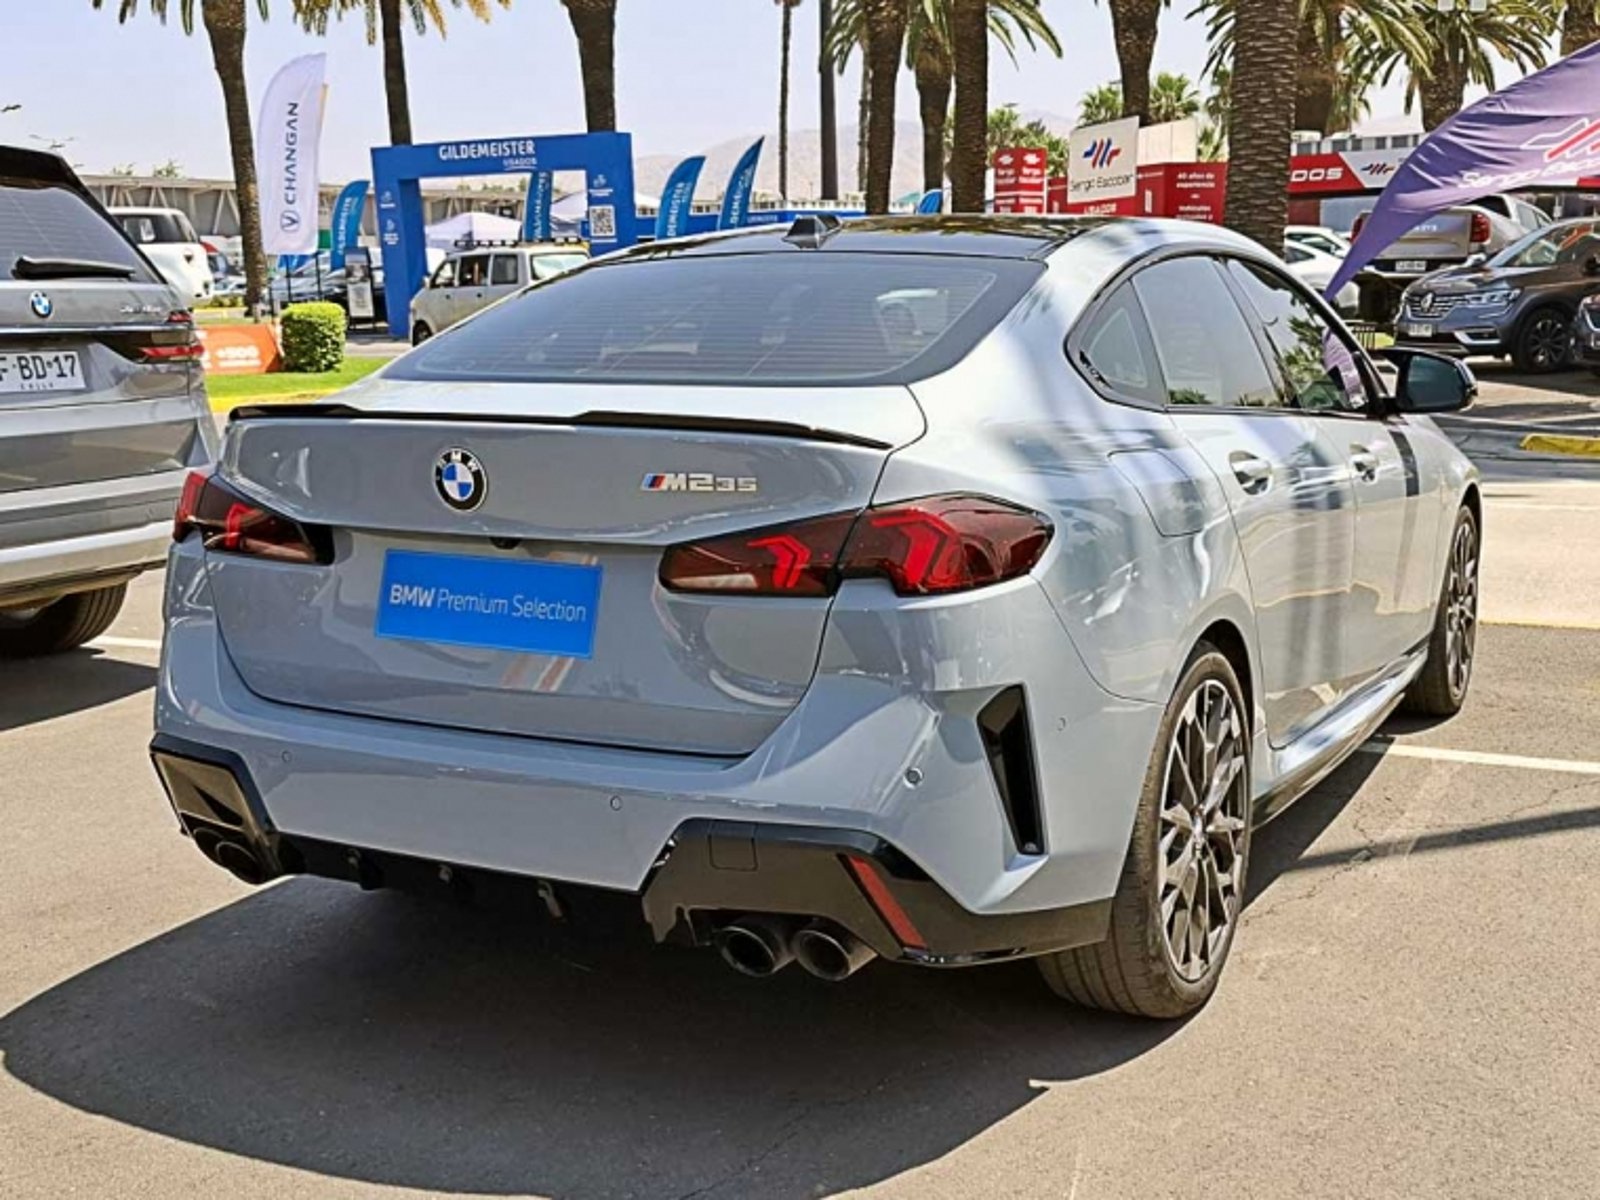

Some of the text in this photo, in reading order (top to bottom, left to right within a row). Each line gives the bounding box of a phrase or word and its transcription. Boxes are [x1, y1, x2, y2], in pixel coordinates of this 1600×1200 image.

[284, 102, 299, 205] CHANGAN
[438, 140, 536, 160] GILDEMEISTER
[389, 584, 587, 622] BMW Premium Selection
